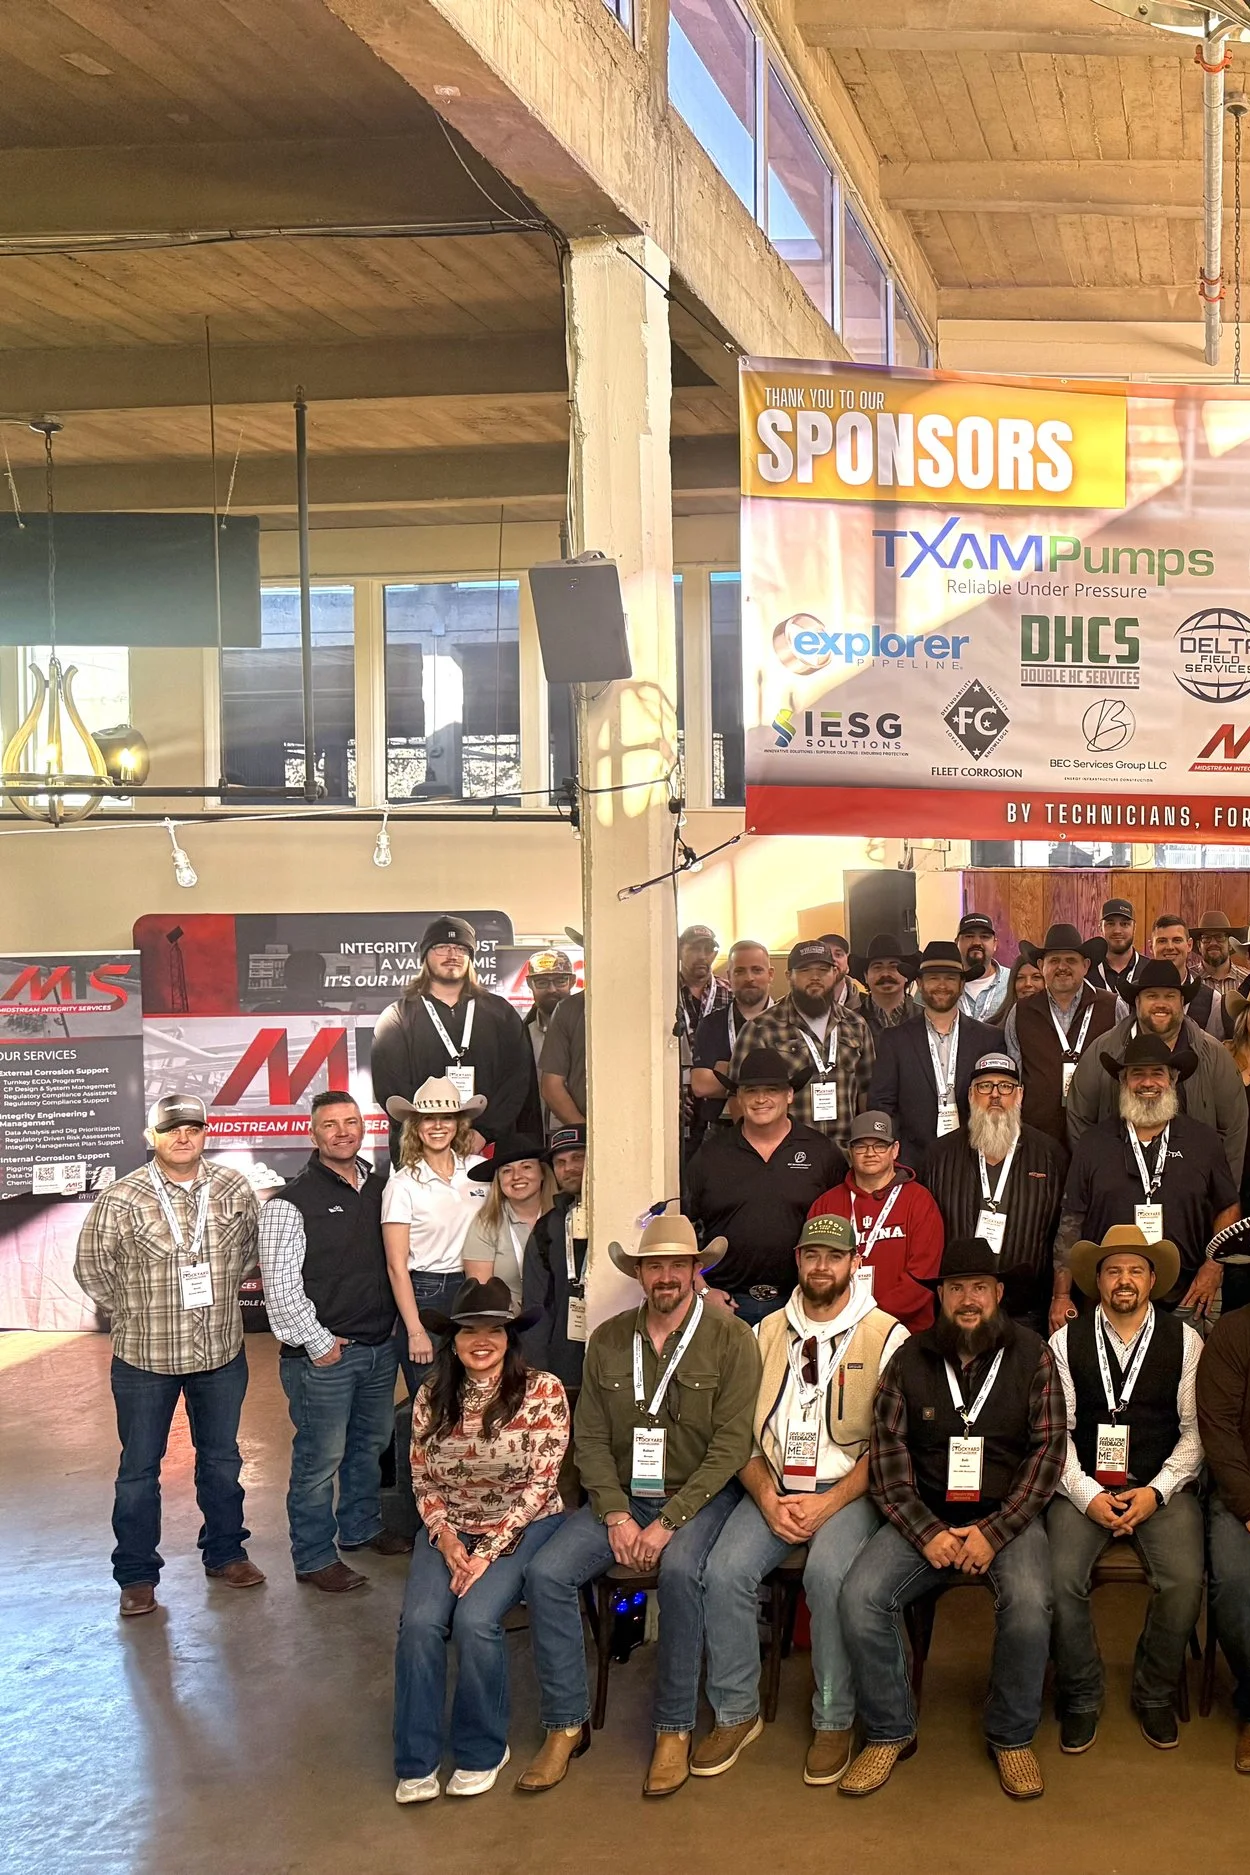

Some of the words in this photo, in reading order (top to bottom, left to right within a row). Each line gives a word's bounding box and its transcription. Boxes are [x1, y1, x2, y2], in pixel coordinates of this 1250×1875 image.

[764, 387, 806, 408] THANK
[810, 388, 835, 409] YOU
[839, 389, 856, 409] TO
[859, 390, 885, 411] OUR
[756, 408, 1074, 493] SPONSORS
[946, 578, 1012, 595] Reliable
[1017, 580, 1070, 597] Under
[1074, 583, 1148, 599] Pressure
[793, 624, 970, 664] explorer
[1020, 614, 1140, 665] DHCS
[857, 658, 961, 670] PIPELINE
[1200, 655, 1240, 664] FIELD
[1020, 668, 1066, 684] DOUBLE
[1068, 668, 1084, 684] HC
[1085, 669, 1140, 686] SERVICES
[986, 685, 1009, 712] INTEGRITY
[804, 711, 903, 740] IESG
[958, 705, 998, 736] FC
[806, 739, 902, 750] SOLUTIONS
[945, 729, 965, 752] LOYALTY
[1049, 758, 1071, 768] BEC
[1073, 759, 1114, 769] Services
[1115, 760, 1146, 771] Group
[1147, 761, 1167, 770] LLC
[931, 766, 959, 777] FLEET
[960, 767, 1023, 778] CORROSION
[1006, 803, 1031, 824] BY
[1045, 804, 1201, 828] TECHNICIANS,
[340, 941, 417, 954] INTEGRITY
[380, 958, 392, 970] A
[0, 964, 132, 1006] MIS
[324, 975, 351, 987] IT'S
[354, 975, 388, 987] OUR
[23, 1050, 77, 1061] SERVICES
[34, 1068, 74, 1076] Corrosion
[76, 1067, 110, 1076] Support
[4, 1100, 41, 1108] Regulatory
[0, 1112, 36, 1121] Integrity
[37, 1110, 88, 1120] Engineering
[0, 1120, 56, 1128] Management
[78, 1125, 121, 1133] Prioritization
[208, 1120, 289, 1133] MIDSTREAM
[4, 1136, 42, 1144] Regulatory
[35, 1142, 80, 1150] Management
[0, 1156, 34, 1164] Internal
[35, 1154, 76, 1162] Corrosion
[76, 1152, 110, 1161] Support
[6, 1166, 33, 1174] Pigging
[788, 1446, 802, 1455] ME
[1098, 1452, 1112, 1460] ME
